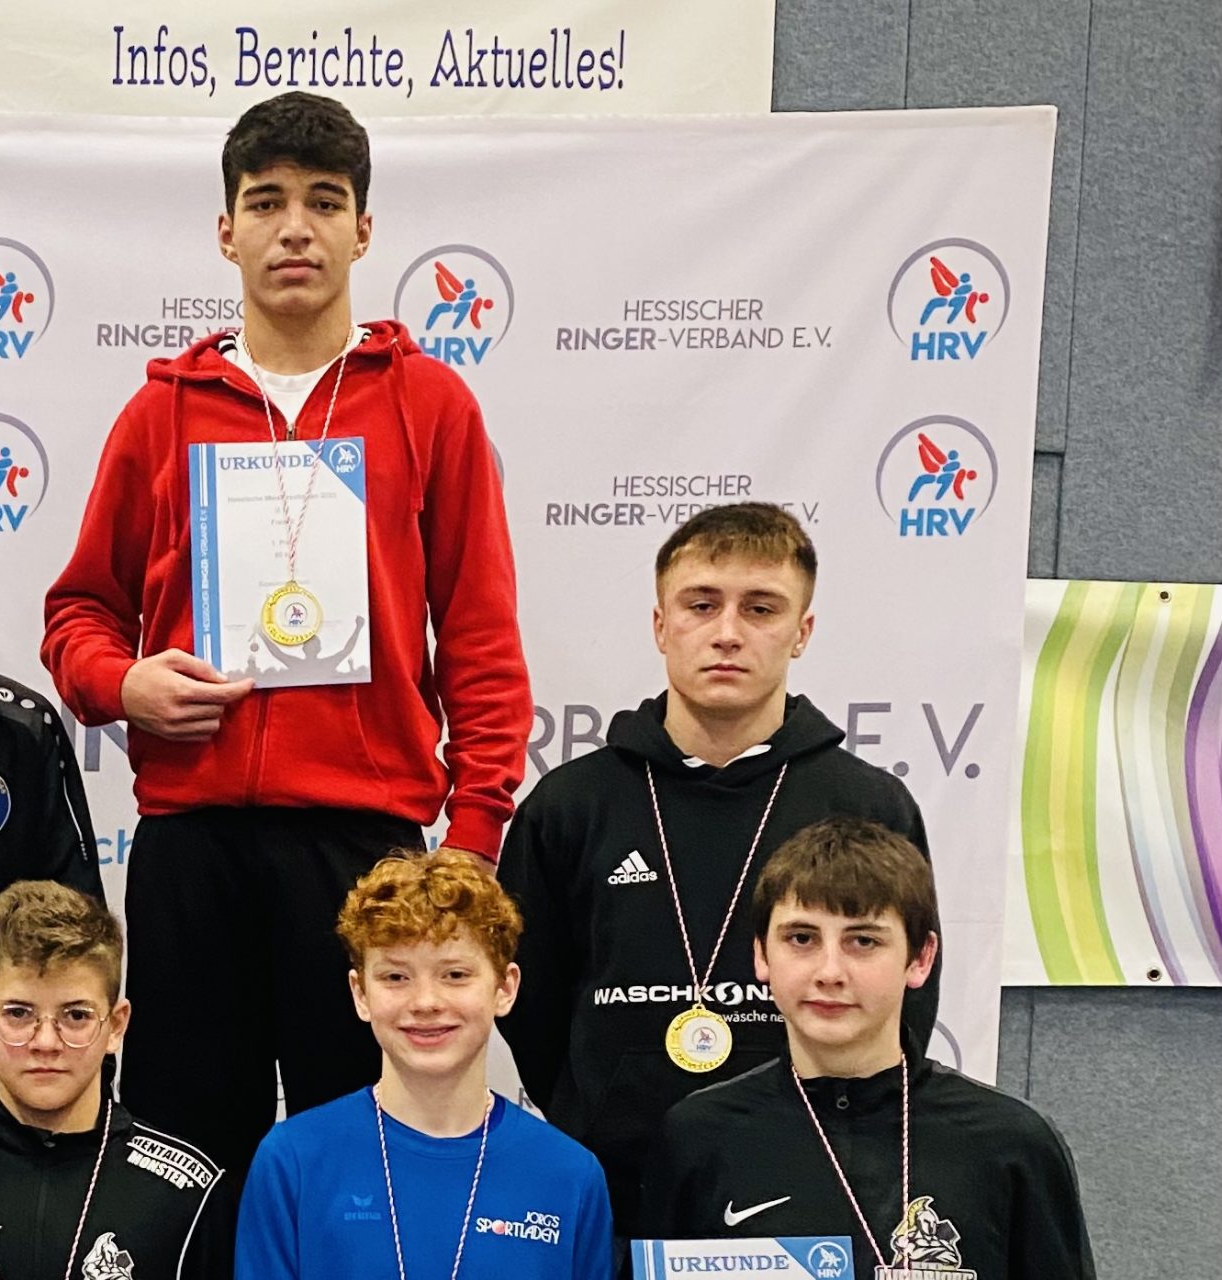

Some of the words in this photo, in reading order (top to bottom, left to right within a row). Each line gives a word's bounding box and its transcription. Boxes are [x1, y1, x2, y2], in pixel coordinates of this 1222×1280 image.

[113, 26, 216, 97] Infos,
[234, 27, 414, 98] Berichte,
[429, 28, 626, 92] Aktuelles!
[623, 299, 763, 321] HESSISCHER
[417, 336, 493, 367] HRV
[556, 327, 784, 352] RINGER-VERBAND
[910, 330, 986, 361] HRV
[220, 454, 315, 471] URKUNDE
[613, 475, 752, 497] HESSISCHER
[899, 508, 975, 538] HRV
[607, 868, 658, 885] adidas
[126, 1149, 188, 1190] MONSTER
[476, 1217, 560, 1245] SPORTLADEN
[669, 1254, 790, 1273] URKUNDE
[817, 1268, 842, 1279] HRV
